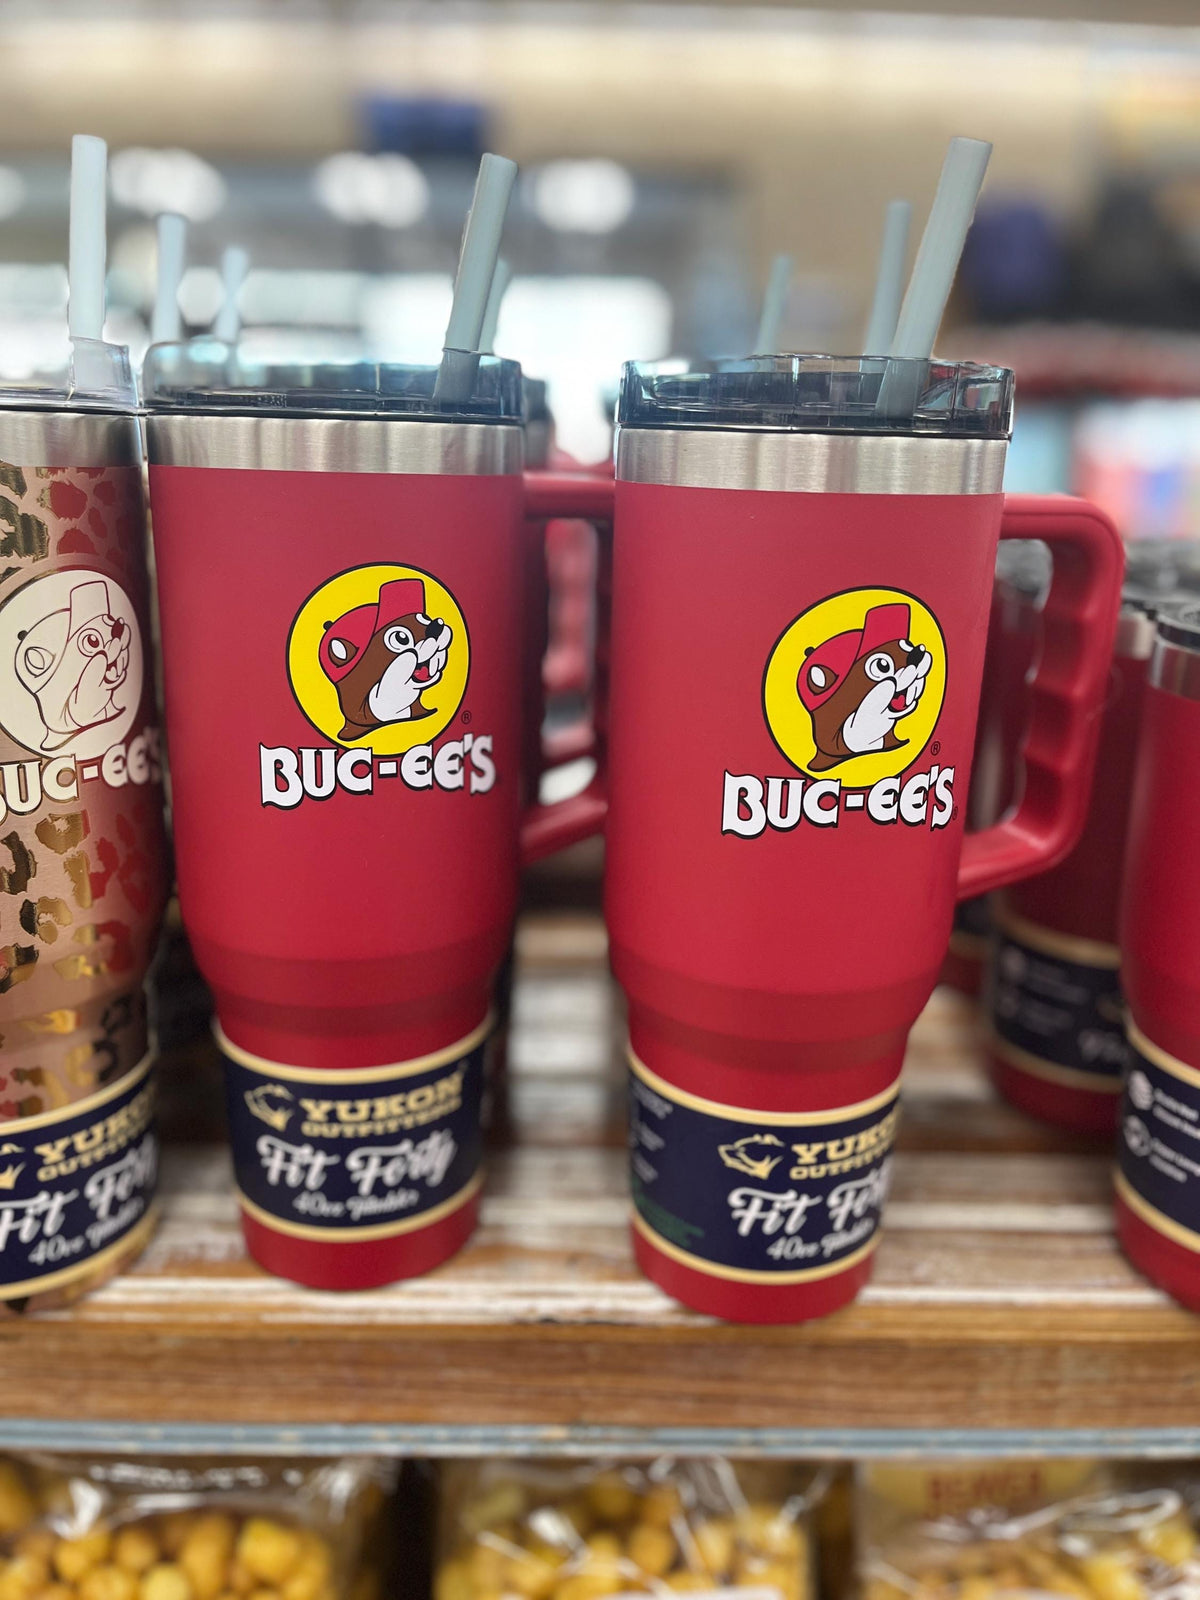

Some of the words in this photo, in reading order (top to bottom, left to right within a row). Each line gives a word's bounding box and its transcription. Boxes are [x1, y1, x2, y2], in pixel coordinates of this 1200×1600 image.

[0, 727, 162, 826] UC-EE'S
[258, 732, 497, 811] BUC-EE'S
[720, 763, 956, 838] BUC-EE'S
[33, 1088, 152, 1166] YUKO
[299, 1070, 465, 1123] YUKON
[36, 1118, 146, 1182] OUTFI
[256, 1134, 341, 1191] Fit
[789, 1136, 893, 1180] OUTFIT
[790, 1107, 898, 1165] YUK
[84, 1133, 157, 1219] For
[727, 1187, 823, 1236] Fit
